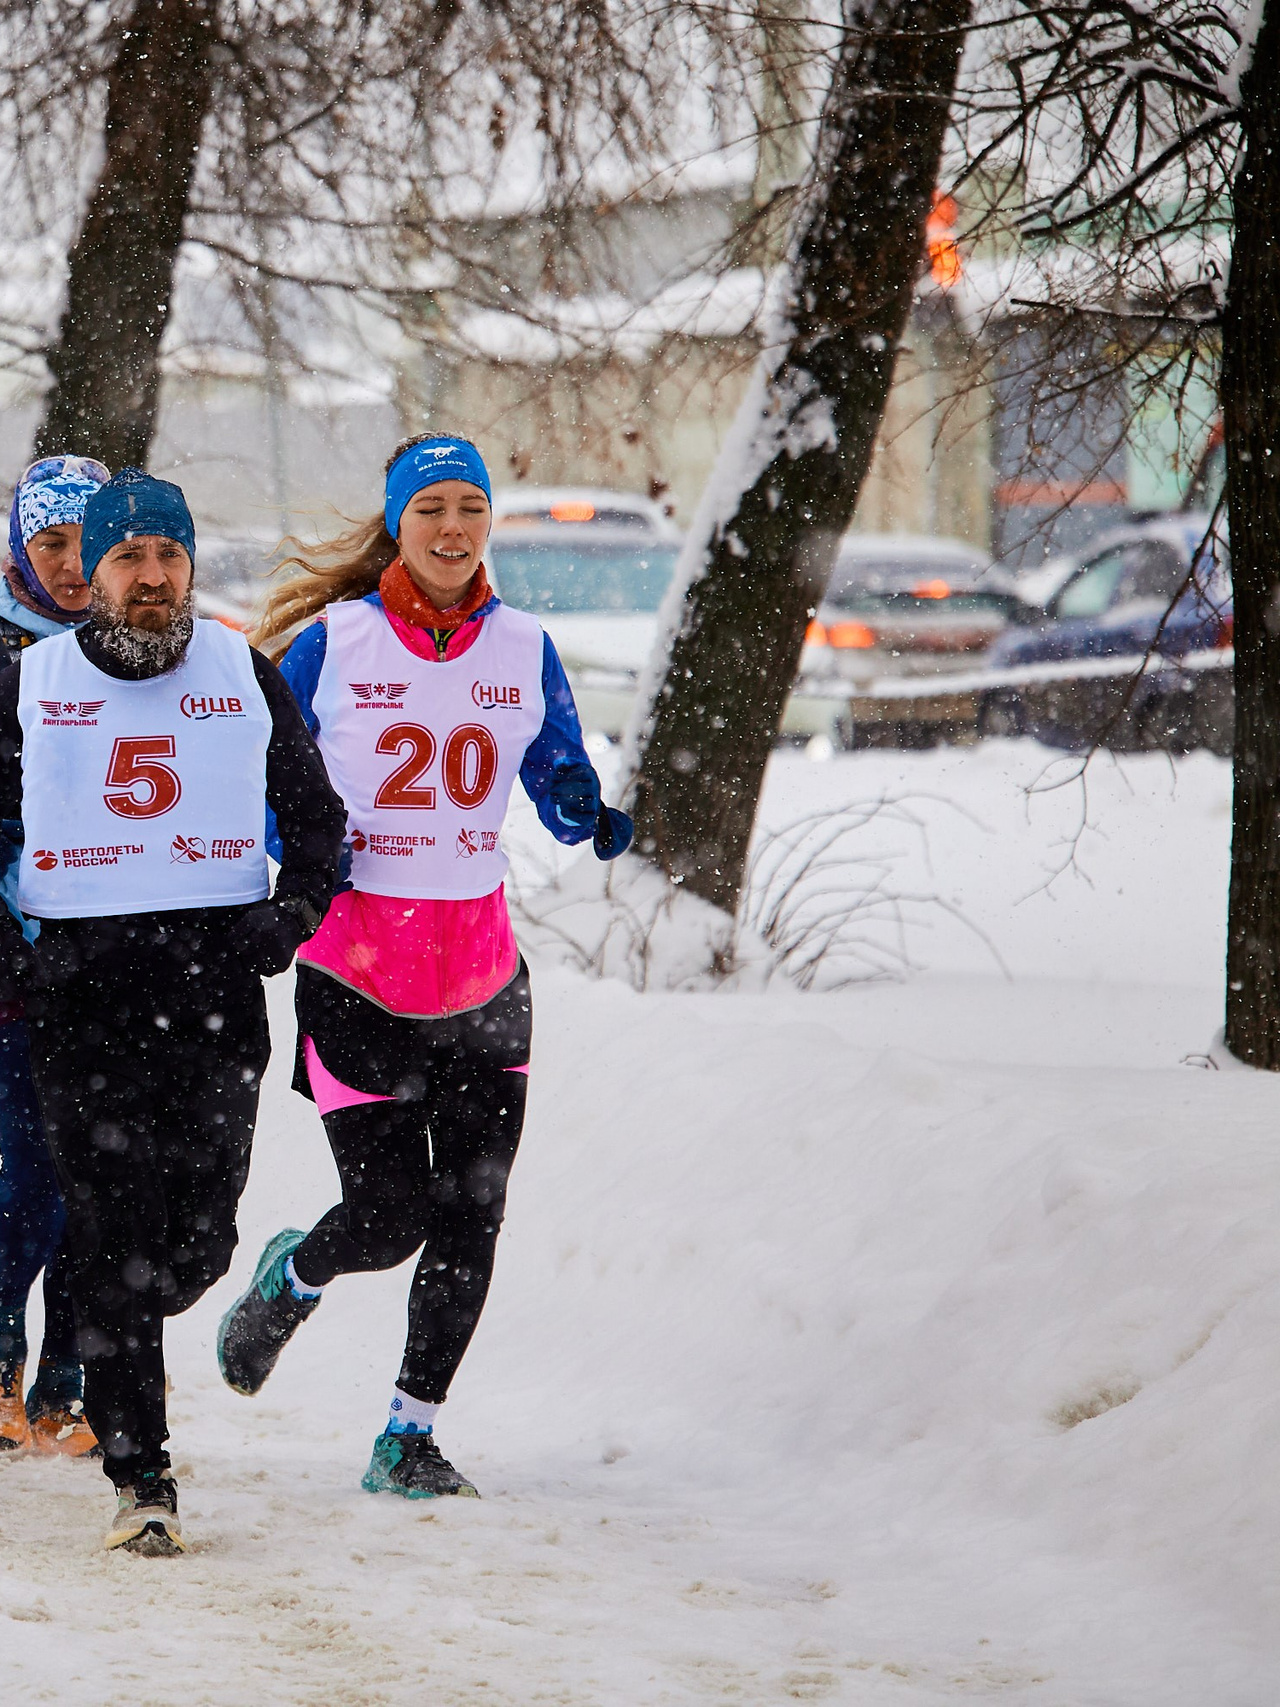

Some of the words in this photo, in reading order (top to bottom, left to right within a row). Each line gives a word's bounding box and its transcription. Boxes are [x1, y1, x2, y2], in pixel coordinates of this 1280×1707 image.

[42, 718, 98, 726] ВИНТОКРЫЛЫЕ
[374, 722, 498, 810] 20
[103, 735, 182, 820] 5
[212, 838, 255, 848] ППОО
[369, 834, 436, 846] ВЕРТОЛЕТЫ
[62, 844, 144, 858] ВЕРТОЛЕТЫ
[211, 848, 242, 860] НЦВ
[370, 844, 413, 857] РОССИИ
[64, 857, 118, 868] РОССИИ
